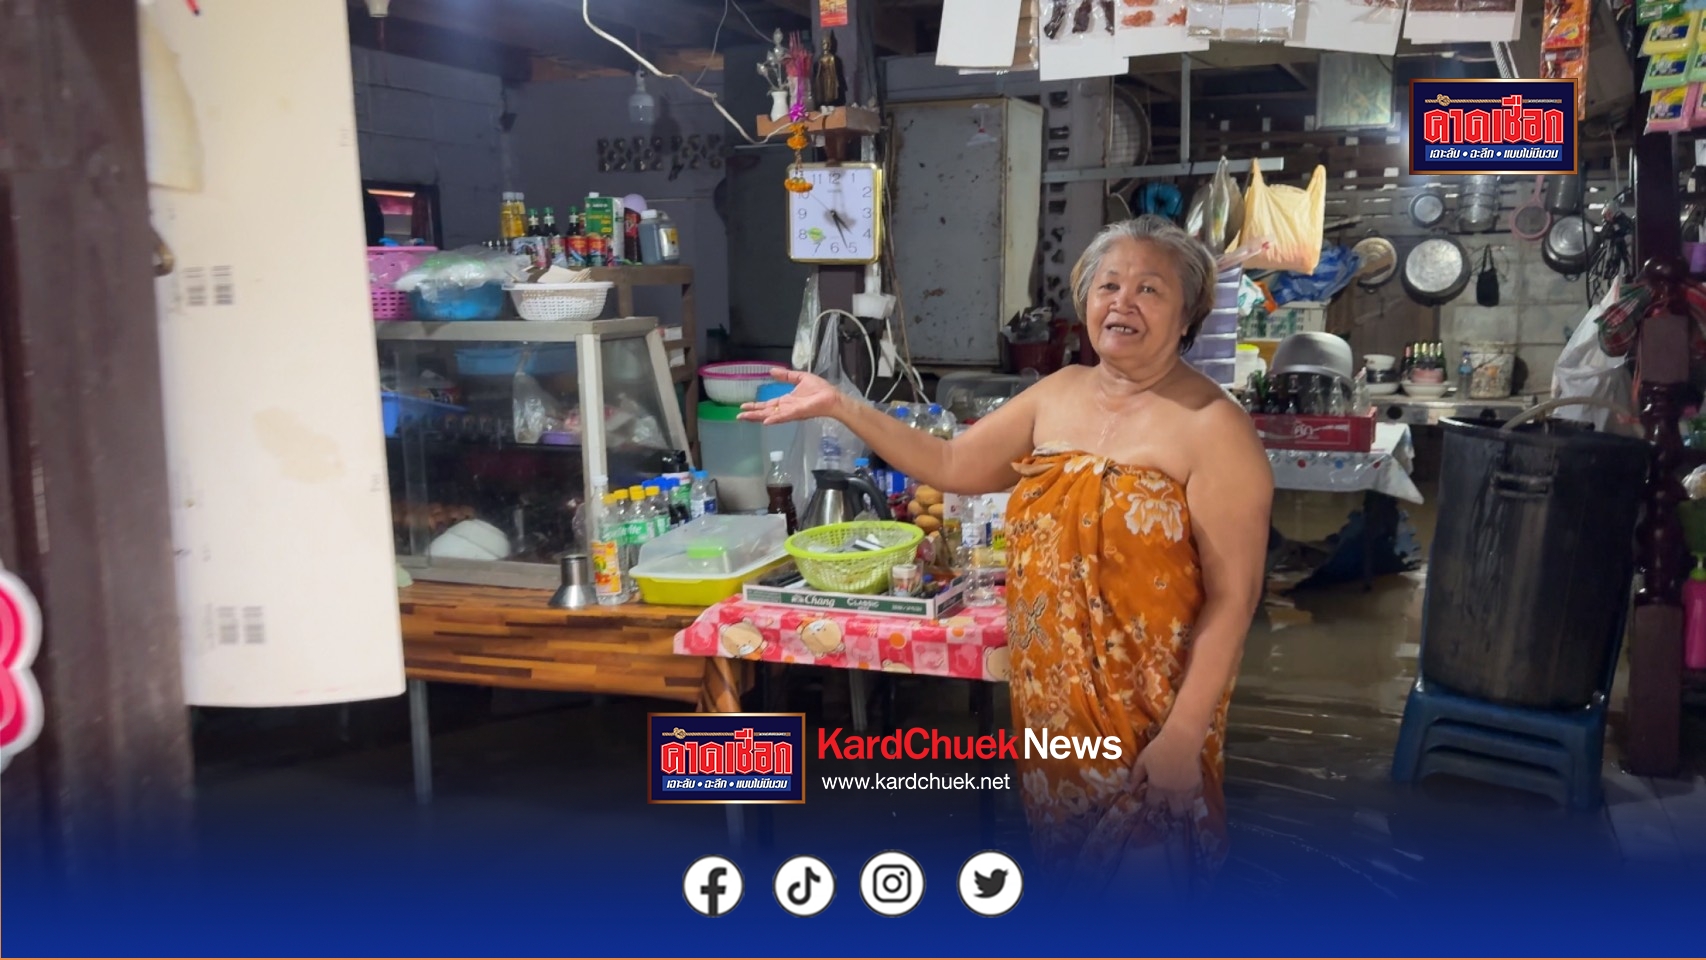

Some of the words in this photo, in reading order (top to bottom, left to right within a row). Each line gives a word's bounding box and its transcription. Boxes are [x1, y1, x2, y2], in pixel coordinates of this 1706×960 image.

[812, 173, 822, 185] 11
[829, 172, 841, 185] 12
[862, 186, 872, 198] 2
[798, 208, 807, 219] 9
[862, 207, 872, 219] 3
[798, 229, 808, 240] 8
[862, 228, 872, 239] 4
[830, 242, 840, 254] 6
[848, 241, 858, 254] 5
[804, 593, 836, 608] Chang
